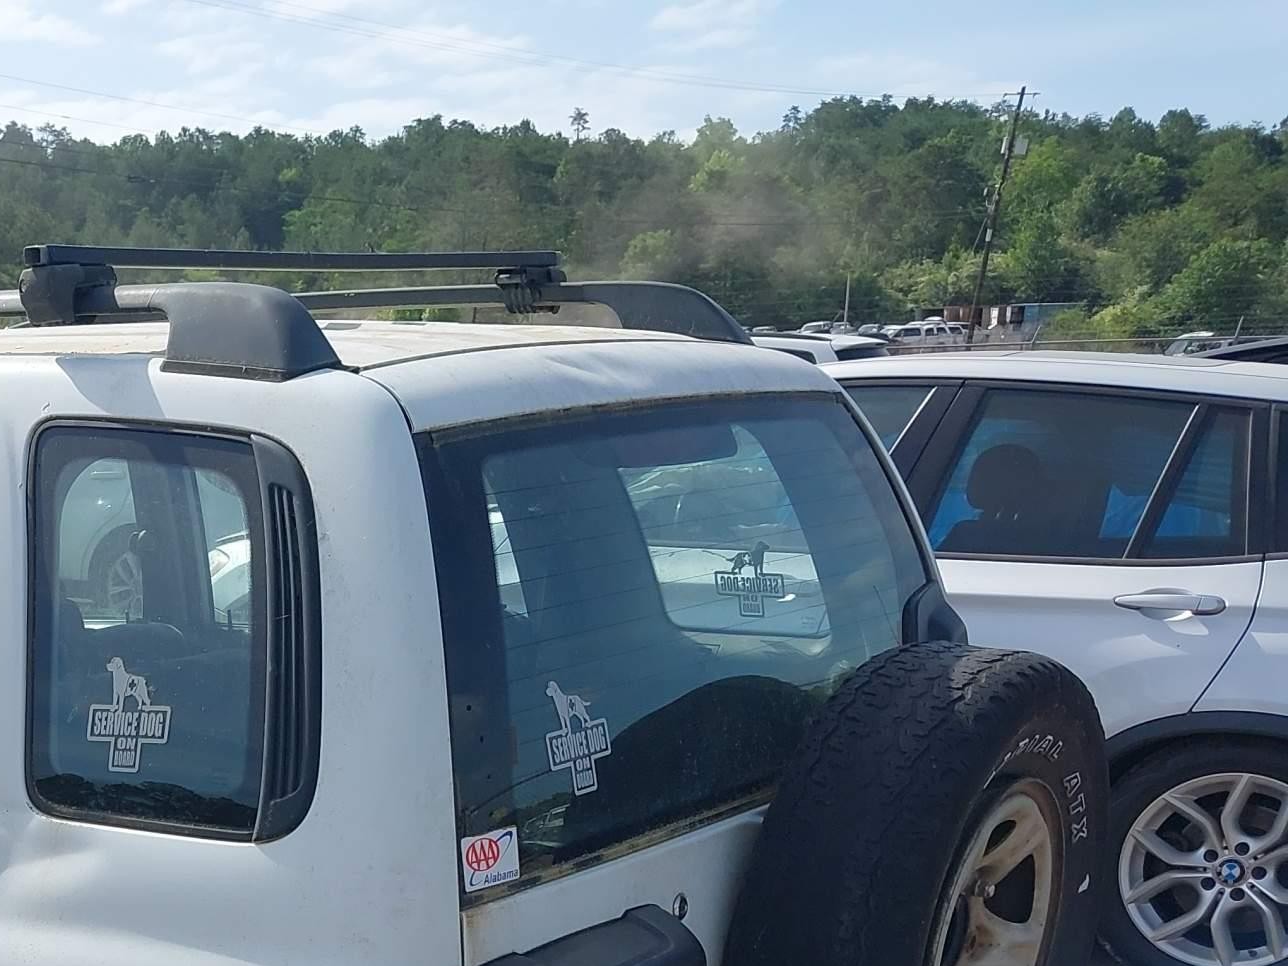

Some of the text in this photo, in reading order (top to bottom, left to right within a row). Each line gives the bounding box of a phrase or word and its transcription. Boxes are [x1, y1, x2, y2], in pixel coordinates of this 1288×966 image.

[94, 712, 163, 737] SERVICE DOG
[116, 738, 136, 750] ON
[553, 726, 607, 763] SERVICE DOG
[575, 757, 591, 771] ON
[1063, 772, 1088, 842] ATX
[469, 839, 499, 871] AAA
[483, 868, 520, 885] Alabama
